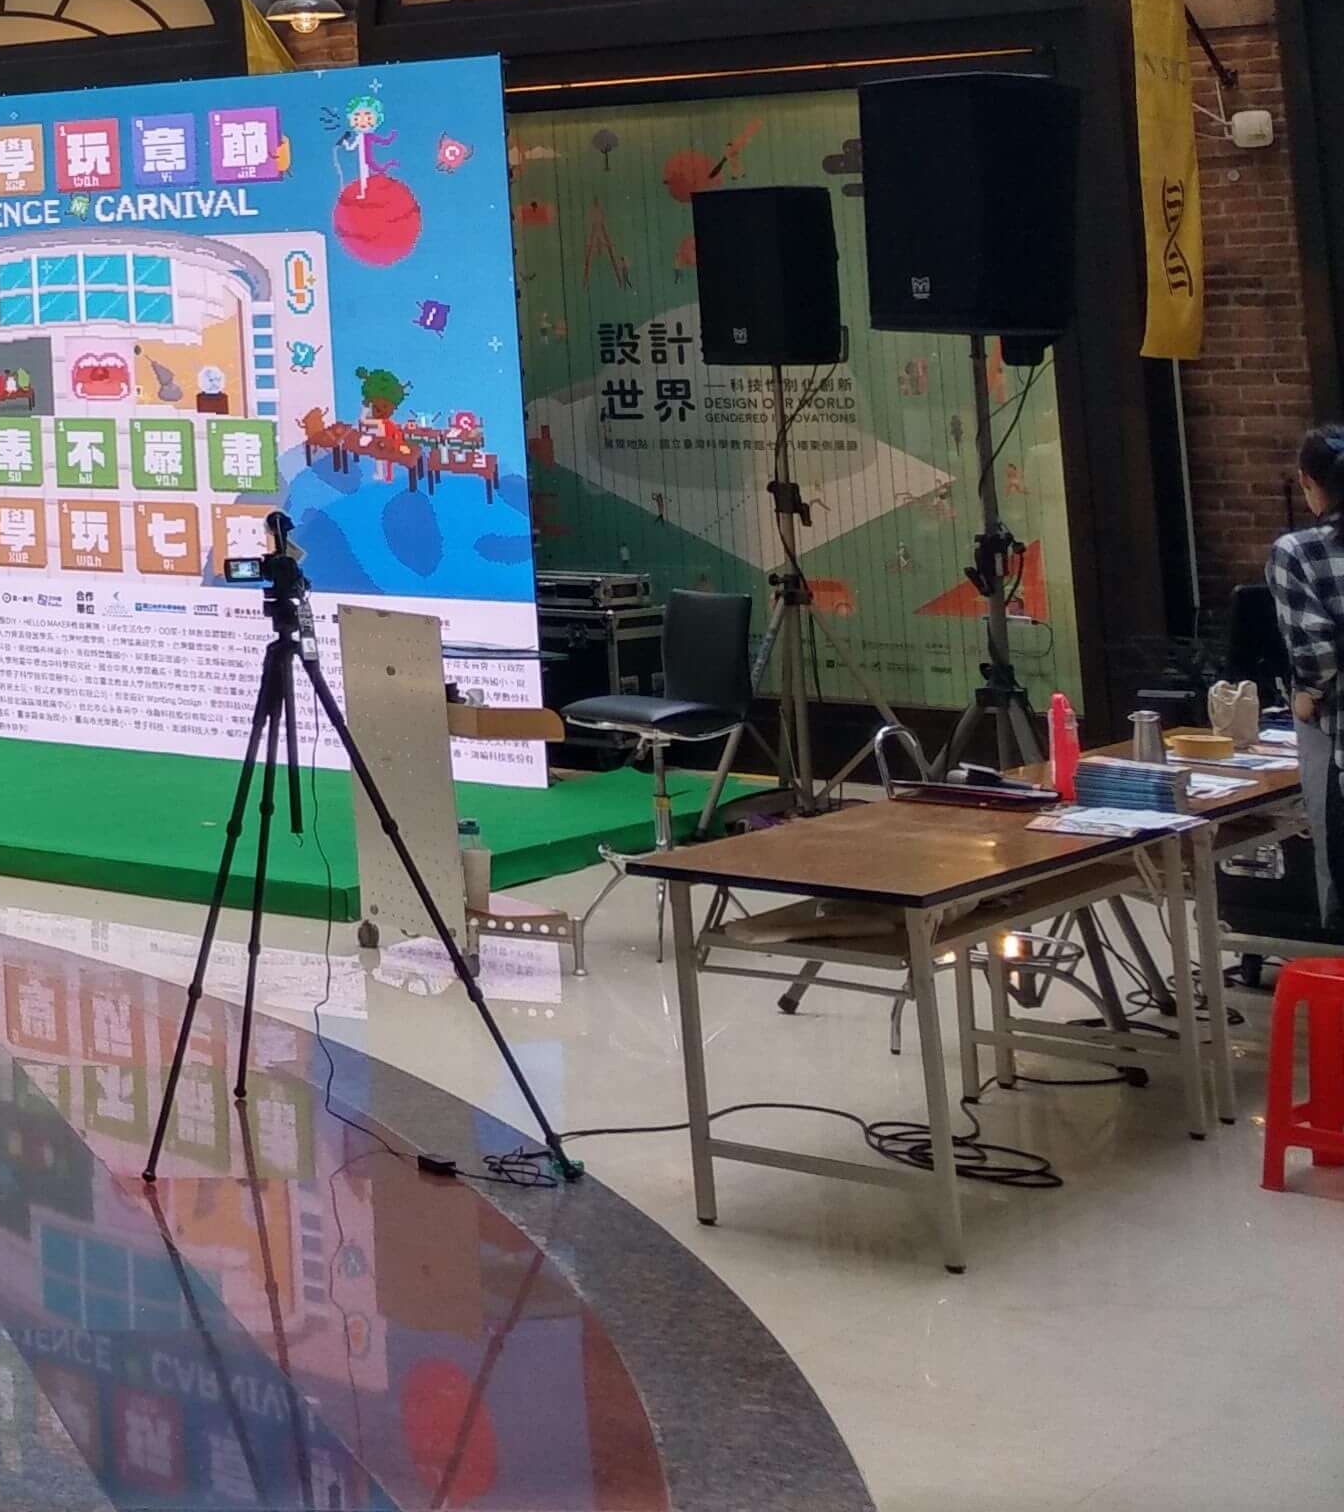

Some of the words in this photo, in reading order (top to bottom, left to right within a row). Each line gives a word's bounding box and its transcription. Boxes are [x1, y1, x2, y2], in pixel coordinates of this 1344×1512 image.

[95, 189, 258, 223] CARNIVAL
[601, 378, 695, 422] 世界
[704, 397, 758, 409] DESIGN
[762, 397, 793, 409] OR
[798, 396, 855, 409] WORLD
[705, 413, 768, 423] GENDERED
[771, 413, 857, 424] INOVATIONS
